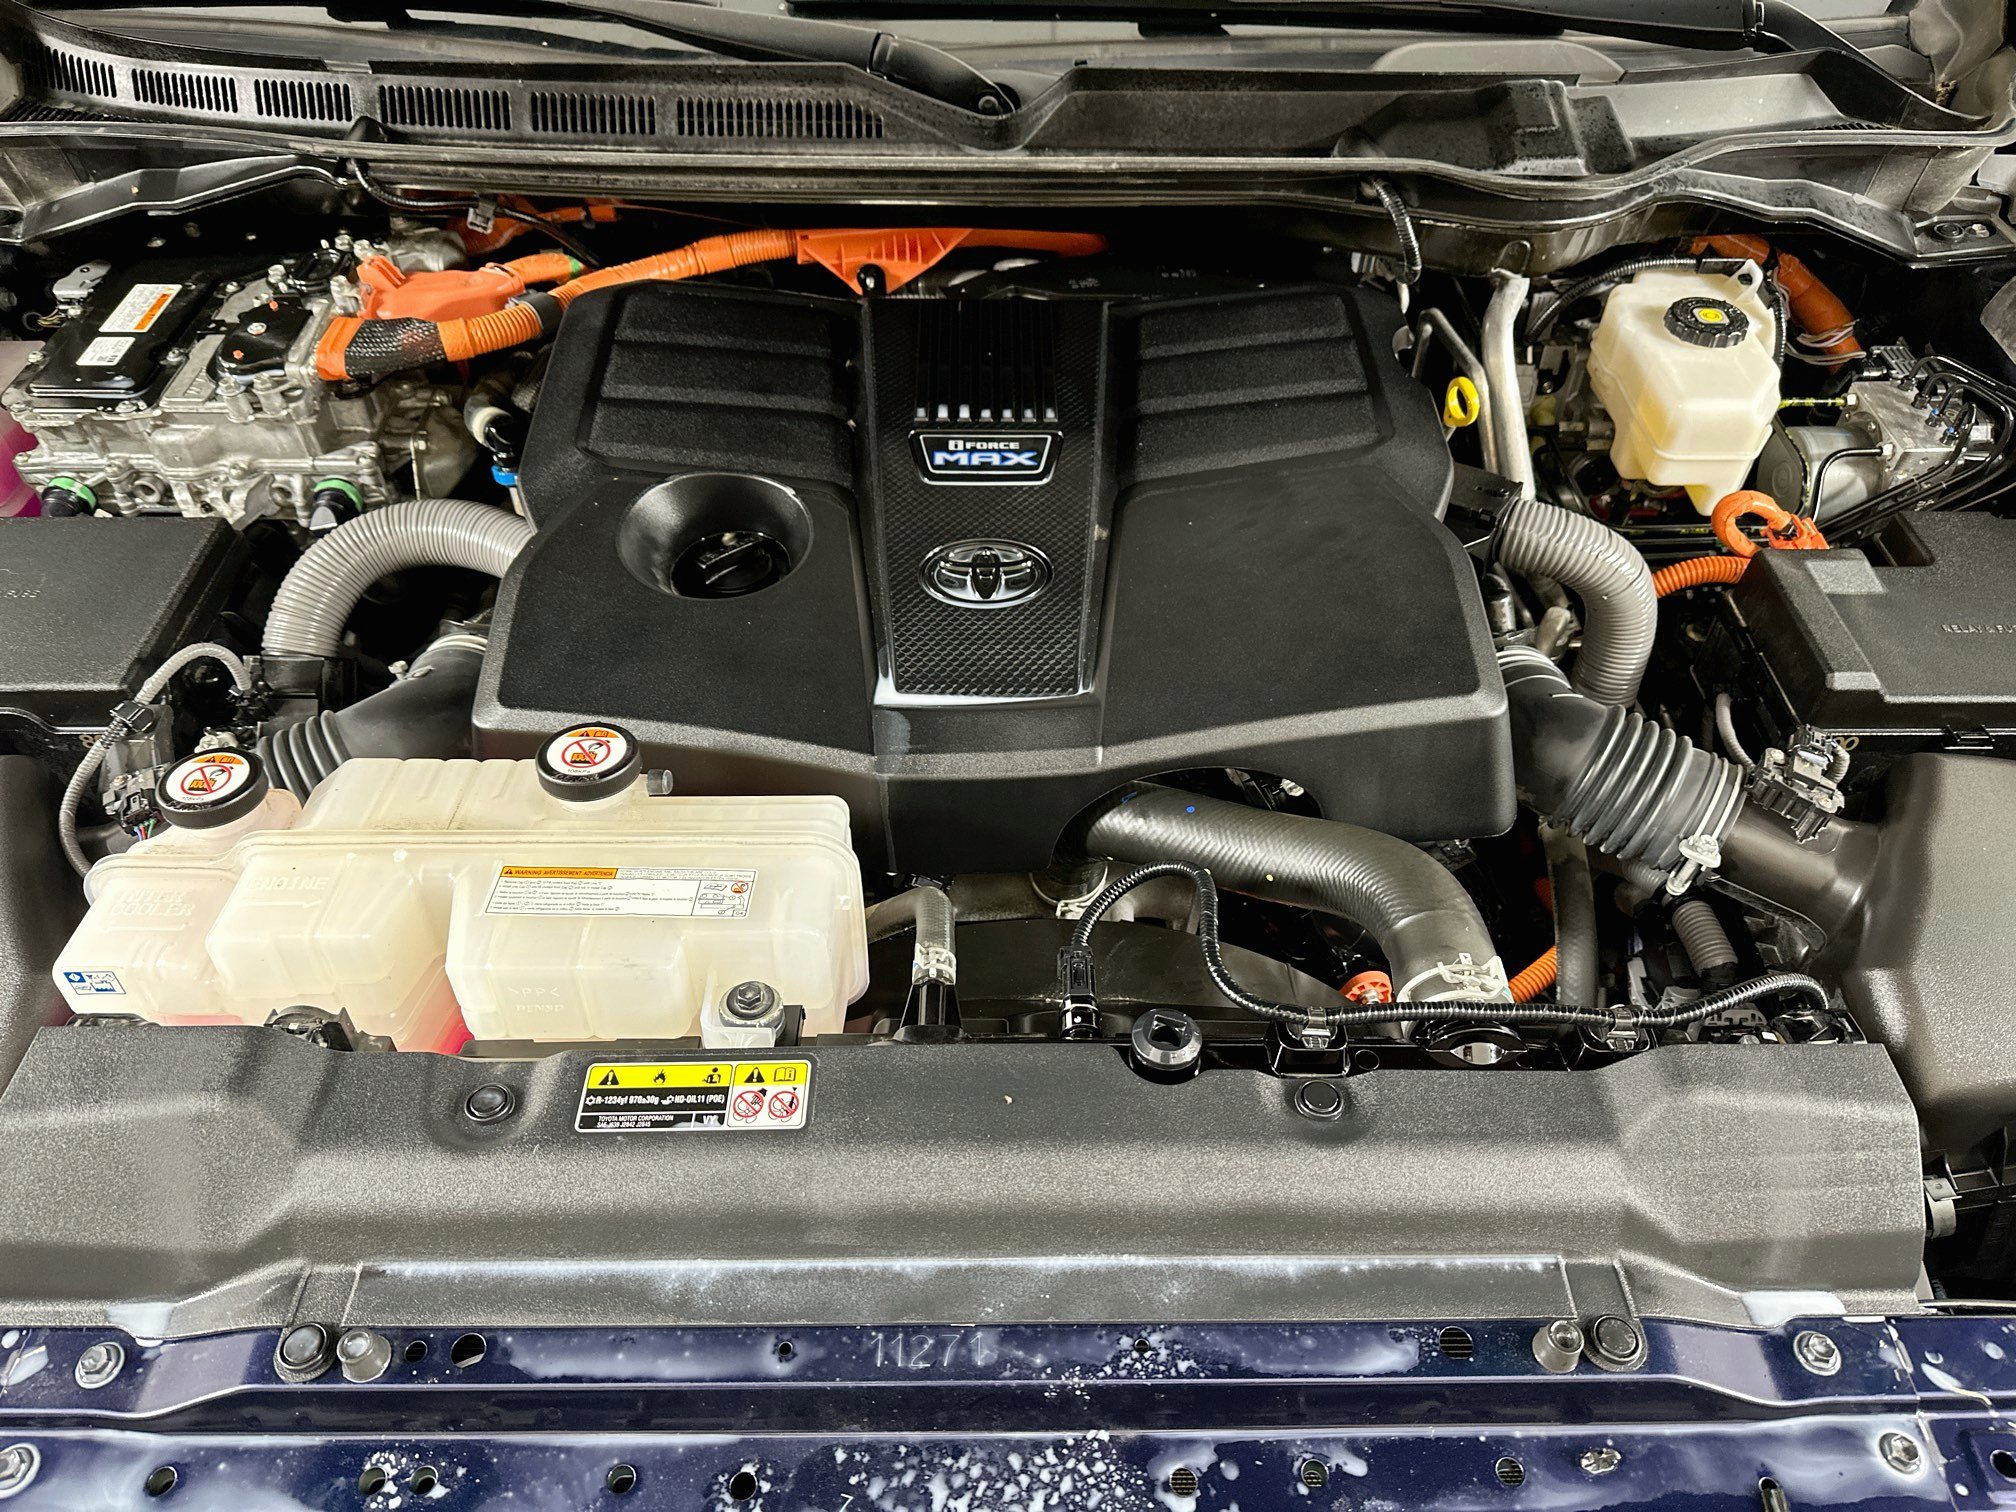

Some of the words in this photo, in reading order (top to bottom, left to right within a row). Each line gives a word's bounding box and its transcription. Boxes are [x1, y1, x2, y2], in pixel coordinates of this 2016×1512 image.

[965, 441, 1021, 450] FORCE
[933, 451, 1038, 466] MAX
[1940, 624, 1983, 634] RELAY
[247, 876, 330, 891] ENGINE
[118, 888, 187, 903] INTER
[110, 902, 196, 917] COOLER
[706, 1094, 725, 1105] (POE)
[871, 1332, 983, 1368] 11271
